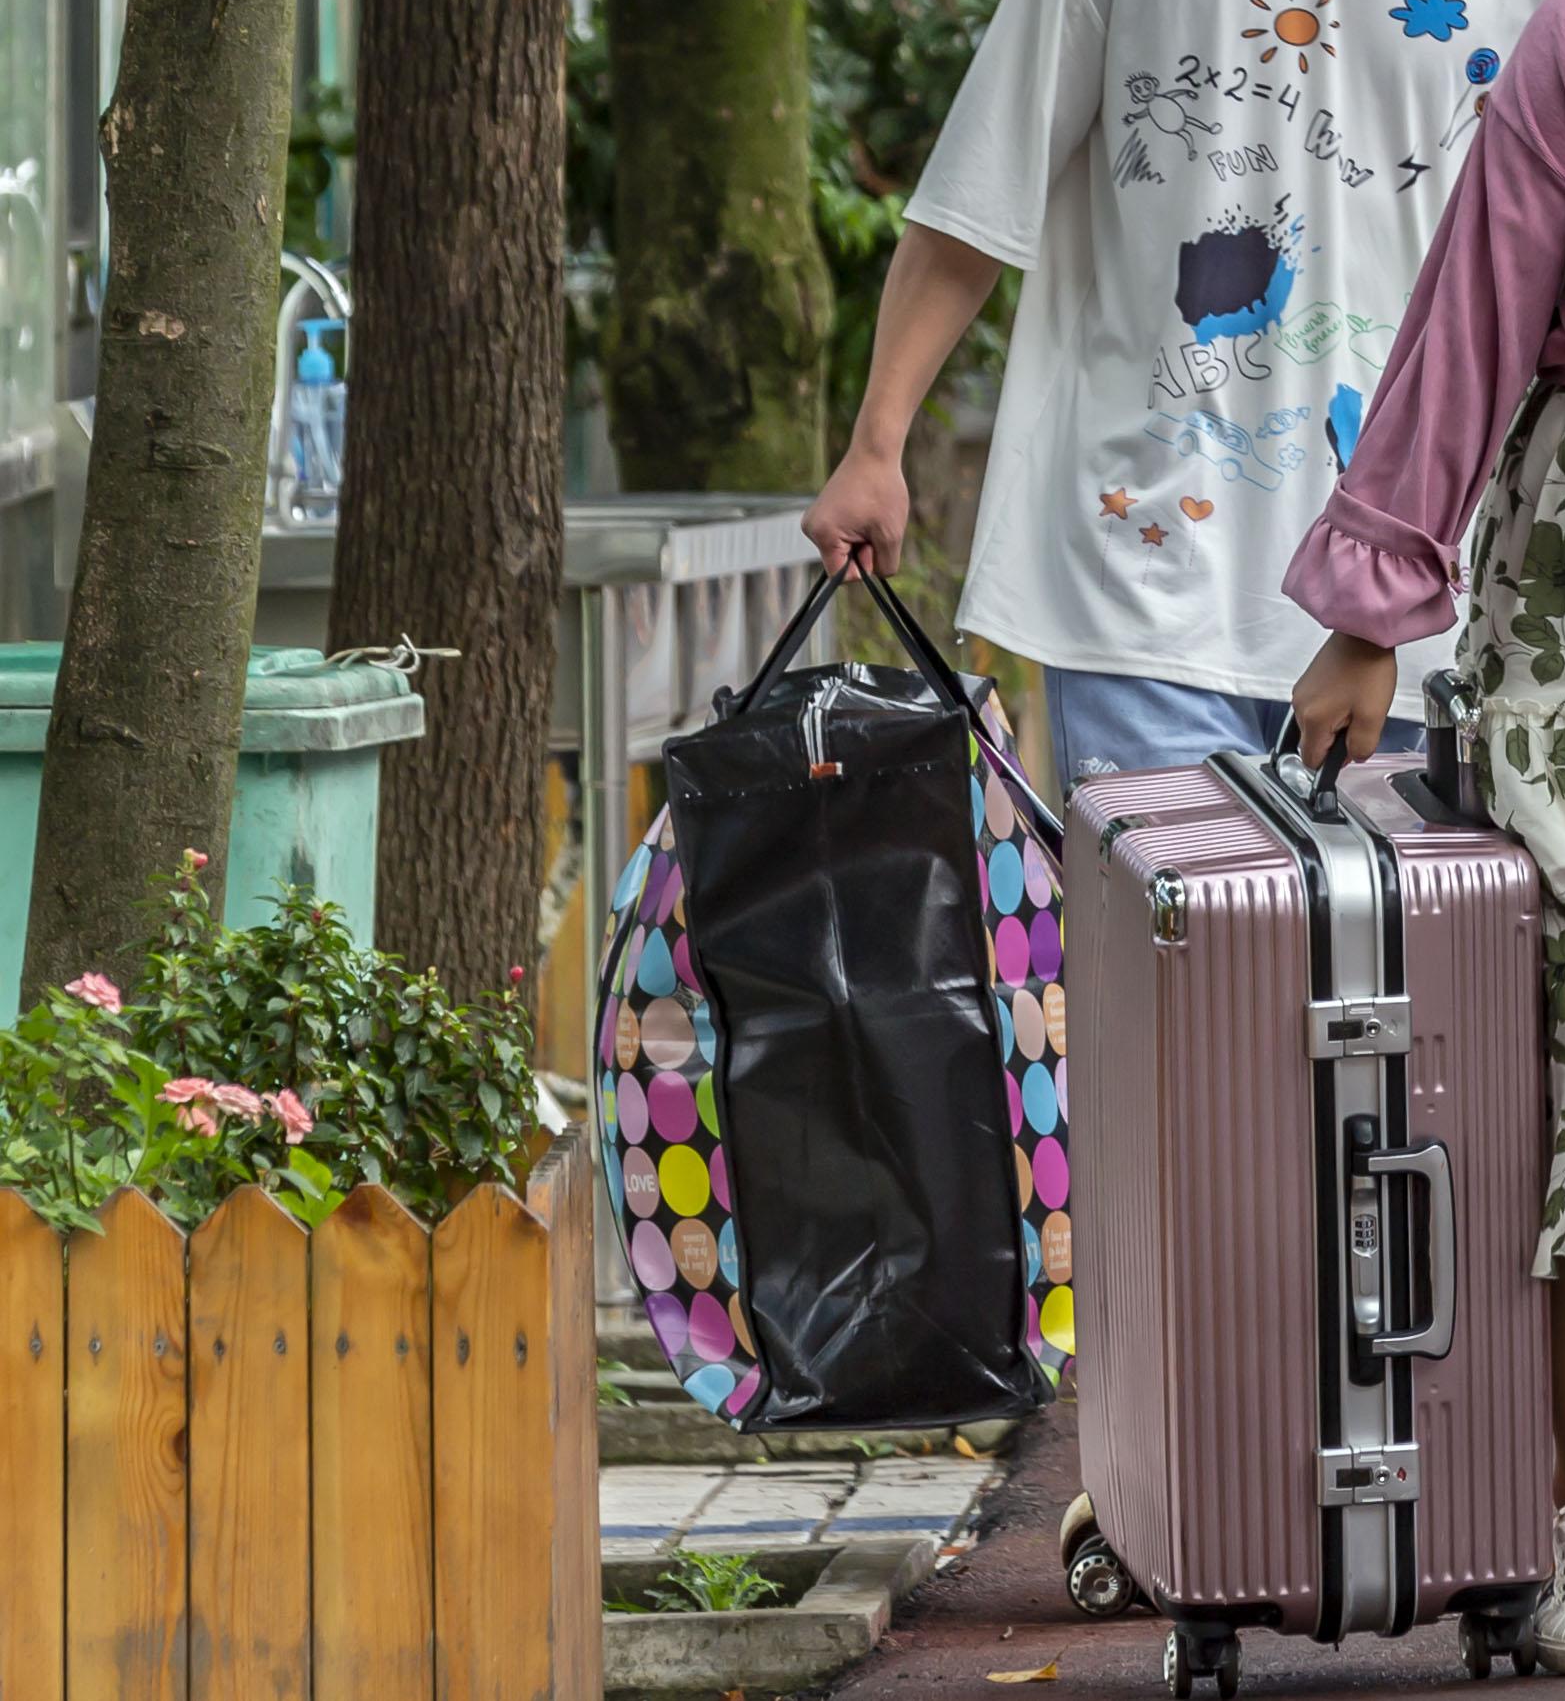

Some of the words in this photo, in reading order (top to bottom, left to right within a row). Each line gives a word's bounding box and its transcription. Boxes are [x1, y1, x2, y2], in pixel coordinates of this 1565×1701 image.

[1206, 143, 1279, 182] FUN
[1146, 330, 1273, 411] ABC
[624, 1173, 656, 1194] LOVE
